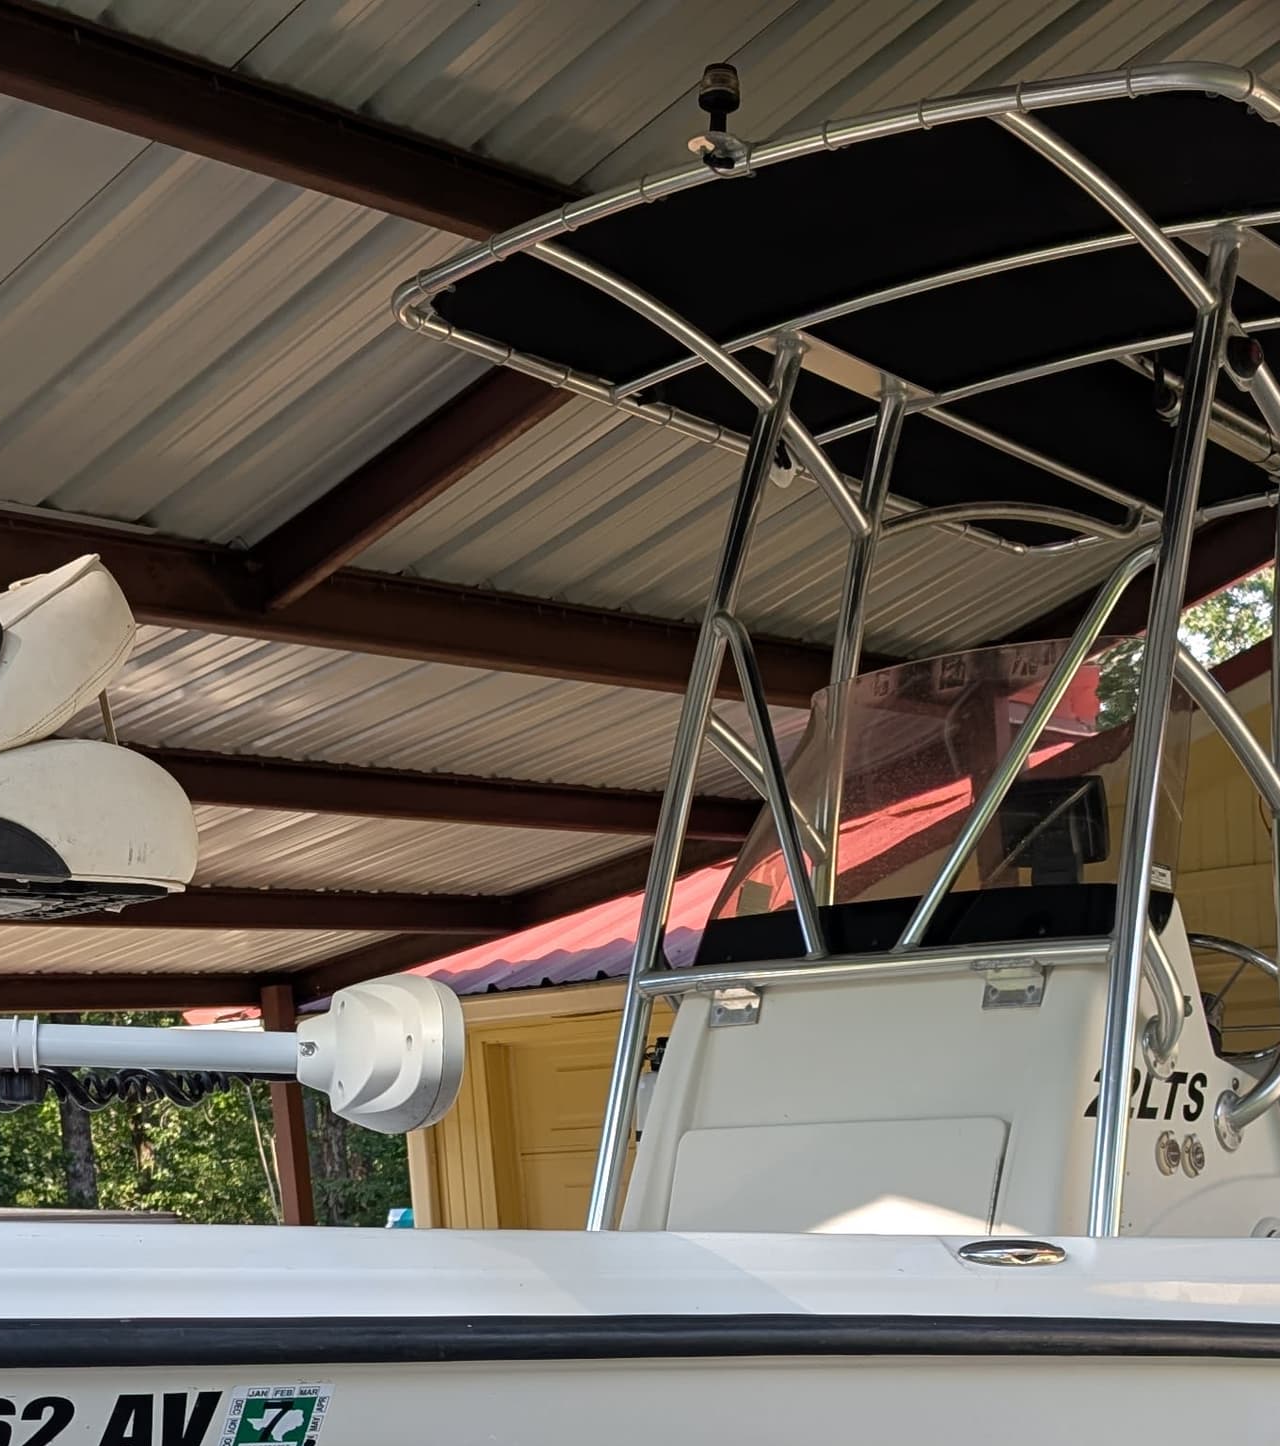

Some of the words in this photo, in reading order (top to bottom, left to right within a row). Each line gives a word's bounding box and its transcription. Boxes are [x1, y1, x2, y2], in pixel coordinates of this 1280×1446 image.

[248, 1389, 269, 1397] JAN
[273, 1389, 294, 1397] FEB
[300, 1388, 319, 1396] MAR
